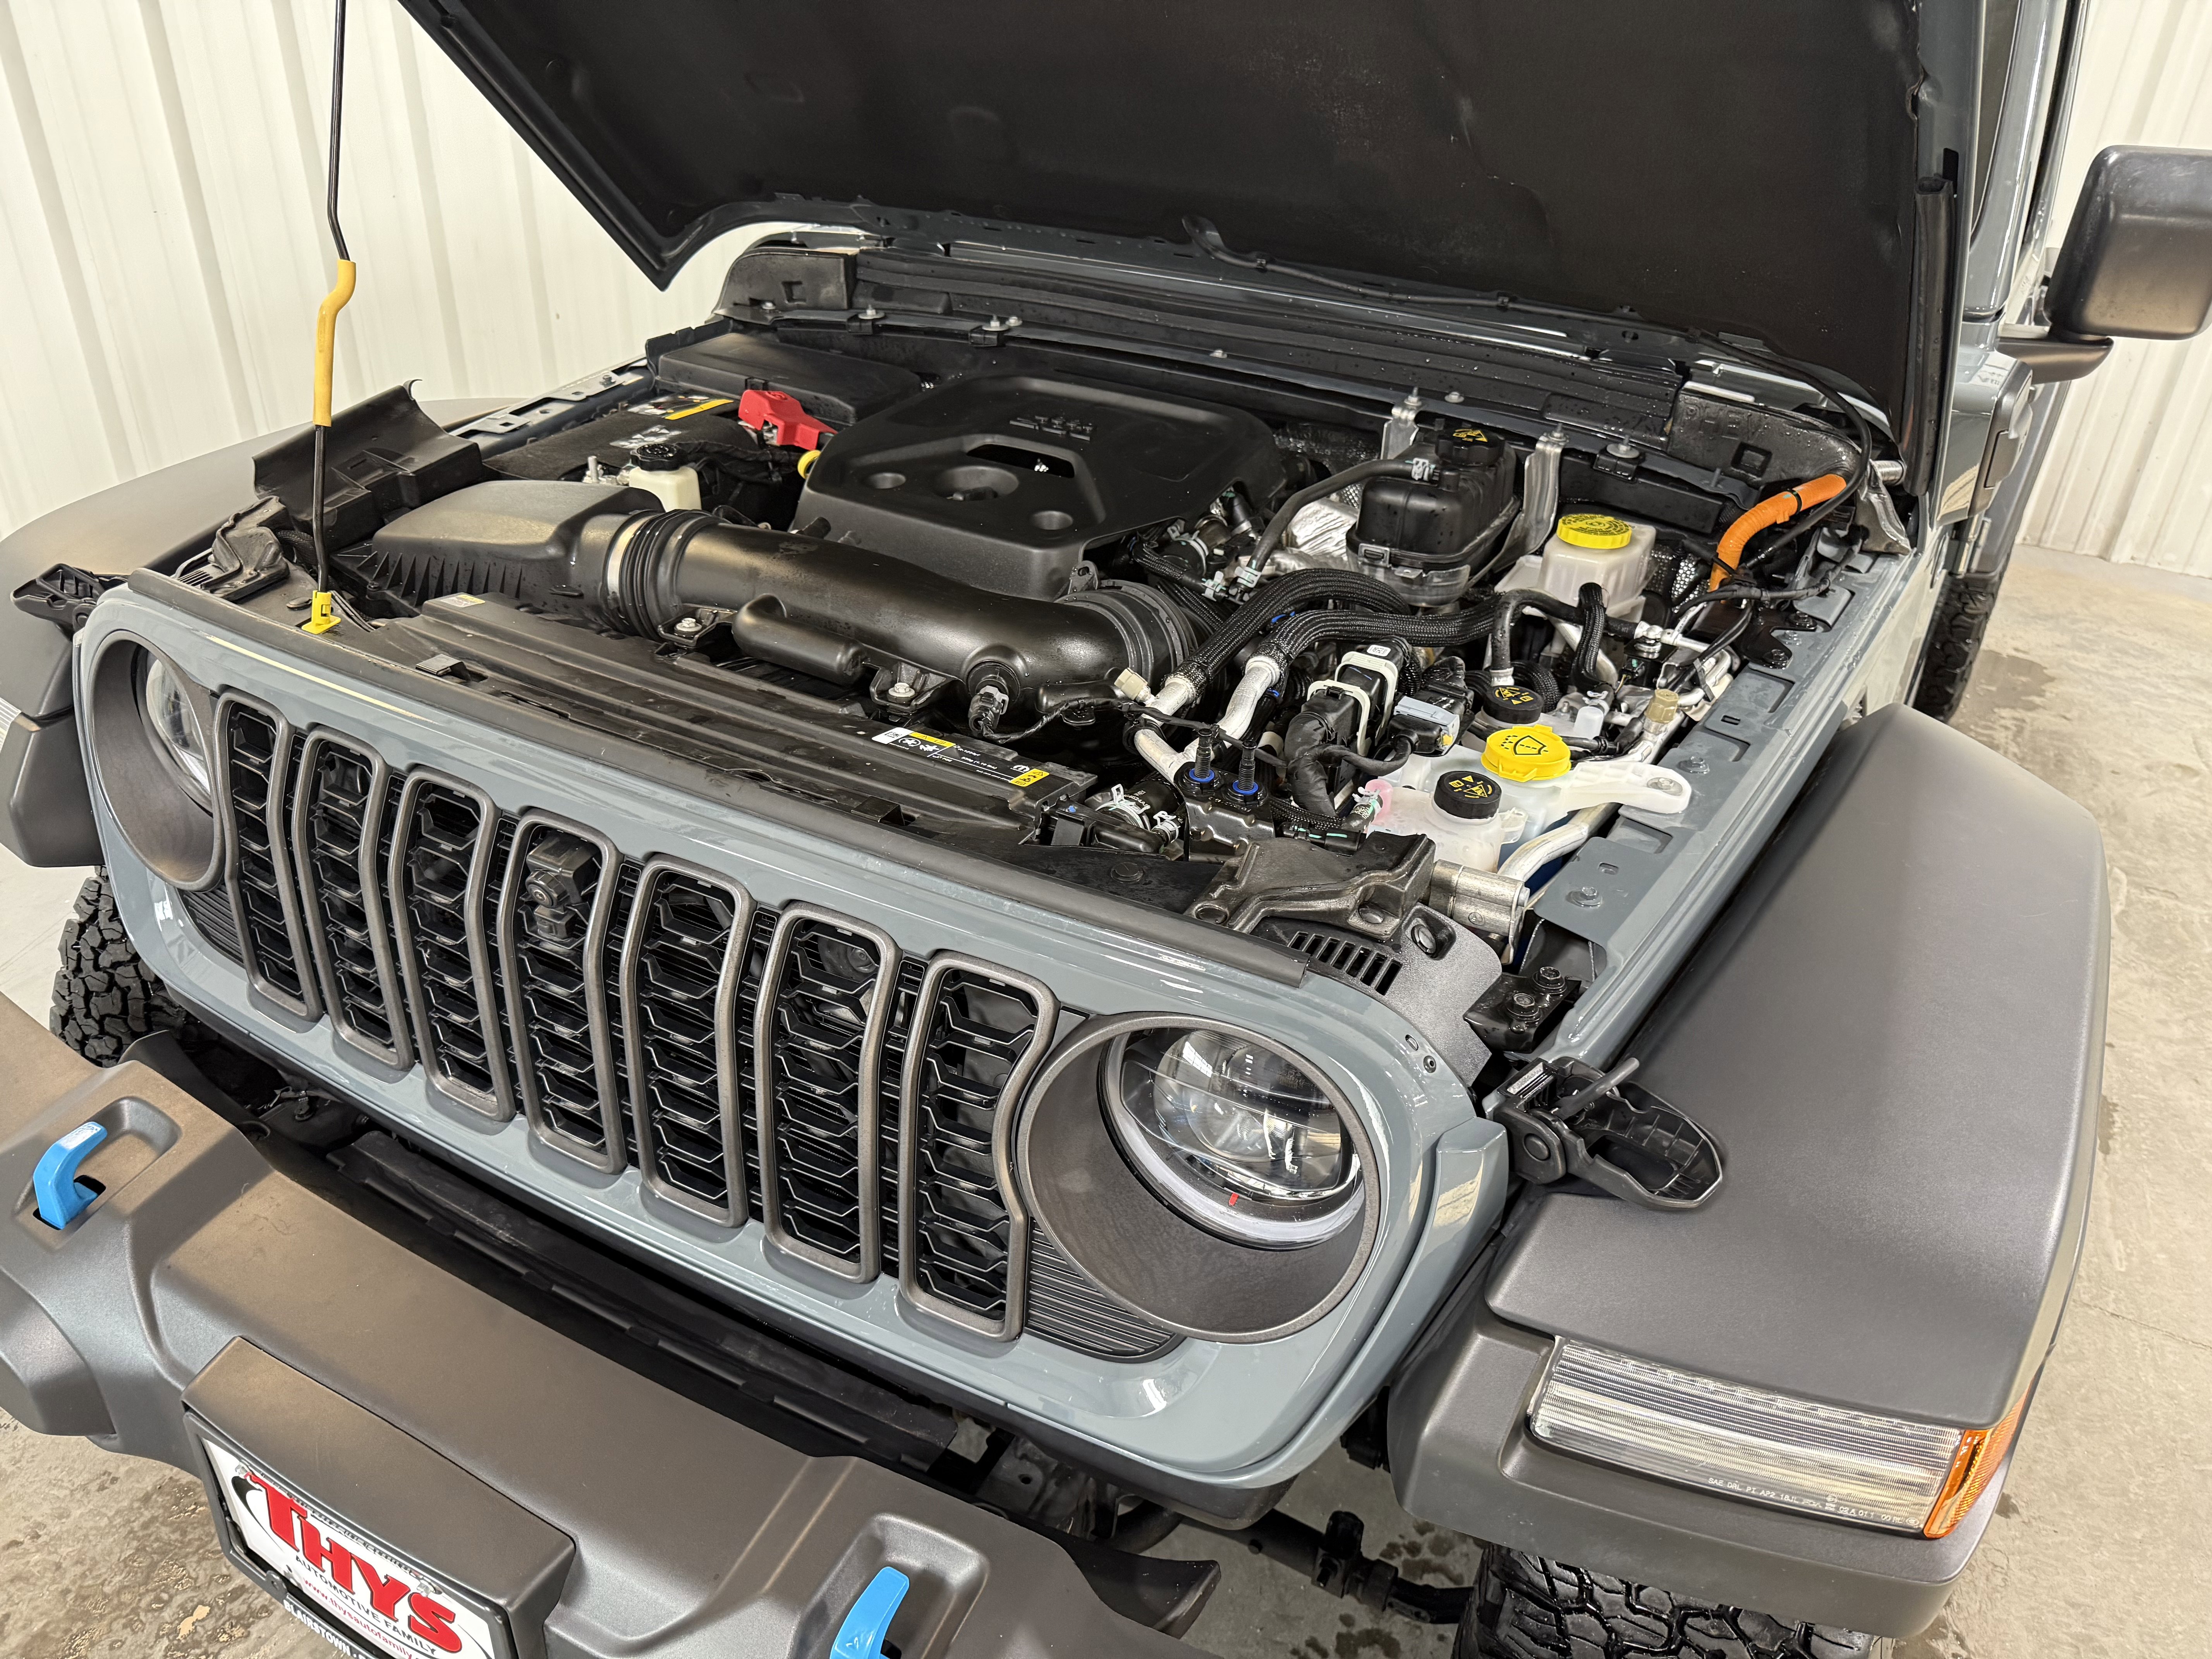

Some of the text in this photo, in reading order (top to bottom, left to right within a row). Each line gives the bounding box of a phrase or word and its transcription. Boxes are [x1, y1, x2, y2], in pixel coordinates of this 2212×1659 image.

[1681, 402, 1768, 441] PHEV
[1708, 1477, 1724, 1486] SAE
[1727, 1482, 1742, 1491] DRL
[246, 1472, 462, 1654] THYS
[283, 1599, 351, 1656] BLAIRSTOWN
[296, 1555, 436, 1656] AUTOMOTIVE FAMILY
[303, 1577, 419, 1659] www.thysautofamily
